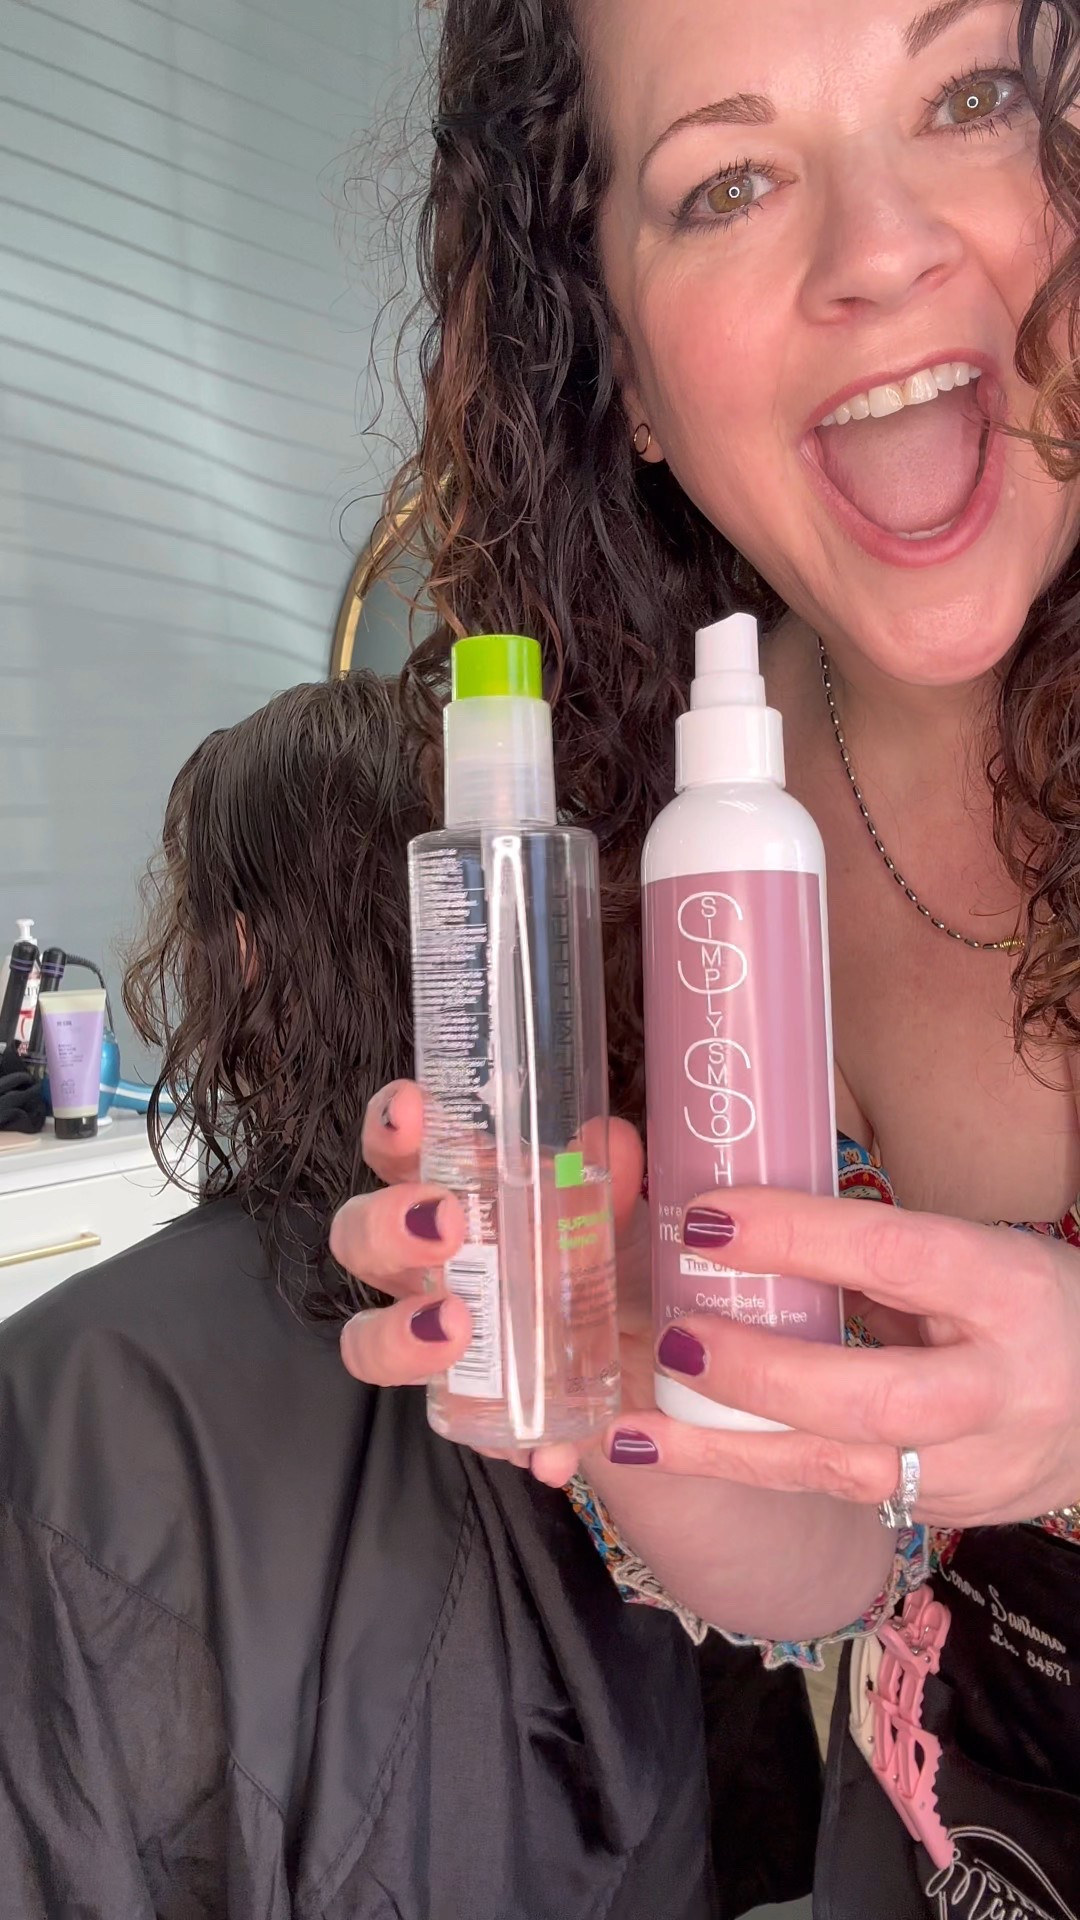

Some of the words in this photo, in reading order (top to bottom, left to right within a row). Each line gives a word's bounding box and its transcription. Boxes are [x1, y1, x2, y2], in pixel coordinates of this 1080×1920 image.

[684, 1258, 708, 1272] The
[695, 1293, 730, 1308] Color
[780, 1310, 807, 1324] Free
